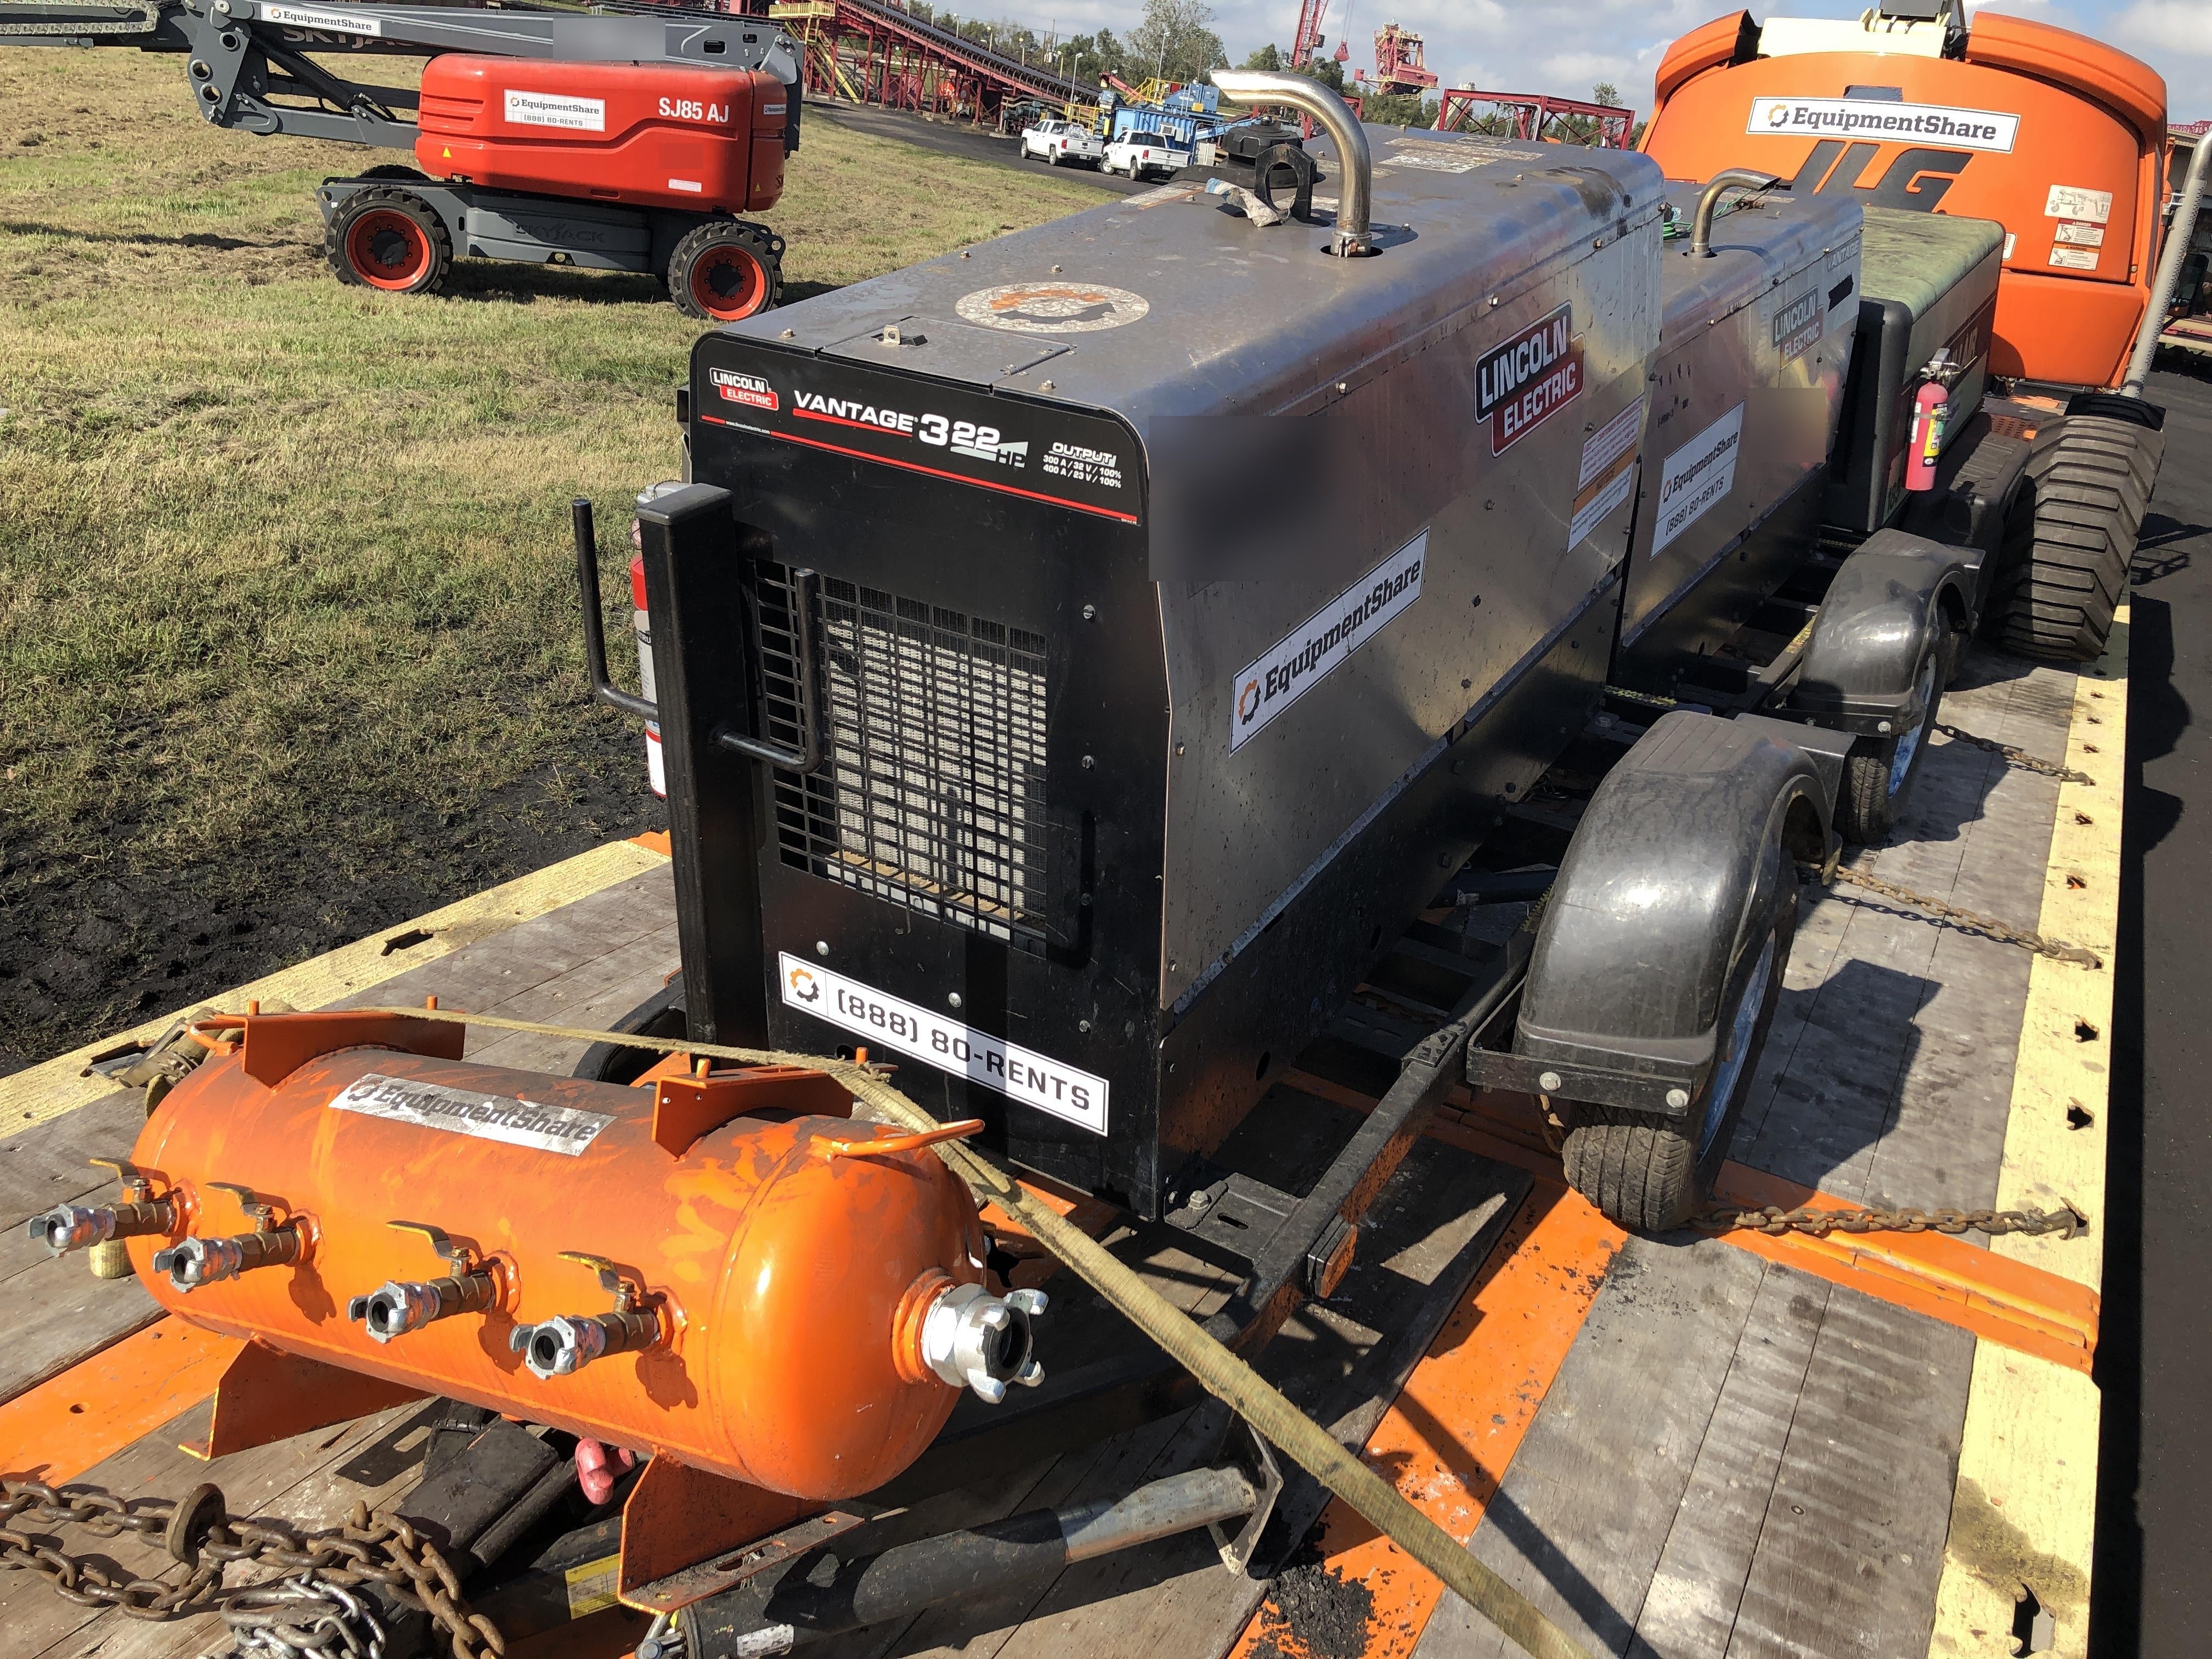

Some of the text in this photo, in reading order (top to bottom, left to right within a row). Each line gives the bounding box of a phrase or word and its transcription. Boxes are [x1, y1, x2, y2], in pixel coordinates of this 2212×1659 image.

[284, 11, 371, 30] EquipmentShare
[521, 99, 599, 114] EquipmentShare
[548, 117, 583, 126] 80-RENTS
[658, 97, 729, 123] SJ85 AJ
[1792, 107, 1996, 140] EquipmentShare
[1826, 240, 1859, 272] VANTAGE
[1775, 294, 1816, 342] LINCOLN
[1784, 321, 1819, 360] ELECTRIC
[1482, 315, 1566, 409] LINCOLN
[713, 371, 765, 393] LINCOLN
[726, 388, 772, 406] ELECTRIC
[1504, 362, 1576, 439] ELECTRIC
[793, 390, 913, 432] VANTAGE
[918, 413, 1001, 453] 322
[1043, 455, 1059, 464] 300
[1073, 461, 1084, 471] 32
[1099, 467, 1121, 479] 100%
[1052, 442, 1112, 464] OUTPUT
[1672, 432, 1738, 494] EquipmentShare
[1043, 464, 1059, 473] 400
[1073, 471, 1084, 479] 23
[1086, 473, 1092, 482] V
[1099, 476, 1121, 488] 100%
[1666, 476, 1724, 536] (888) 80-RENTS
[1263, 560, 1420, 702] EquipmentShare
[838, 989, 1090, 1110] (888) 80-RENTS
[374, 1085, 596, 1141] EquipmentShare
